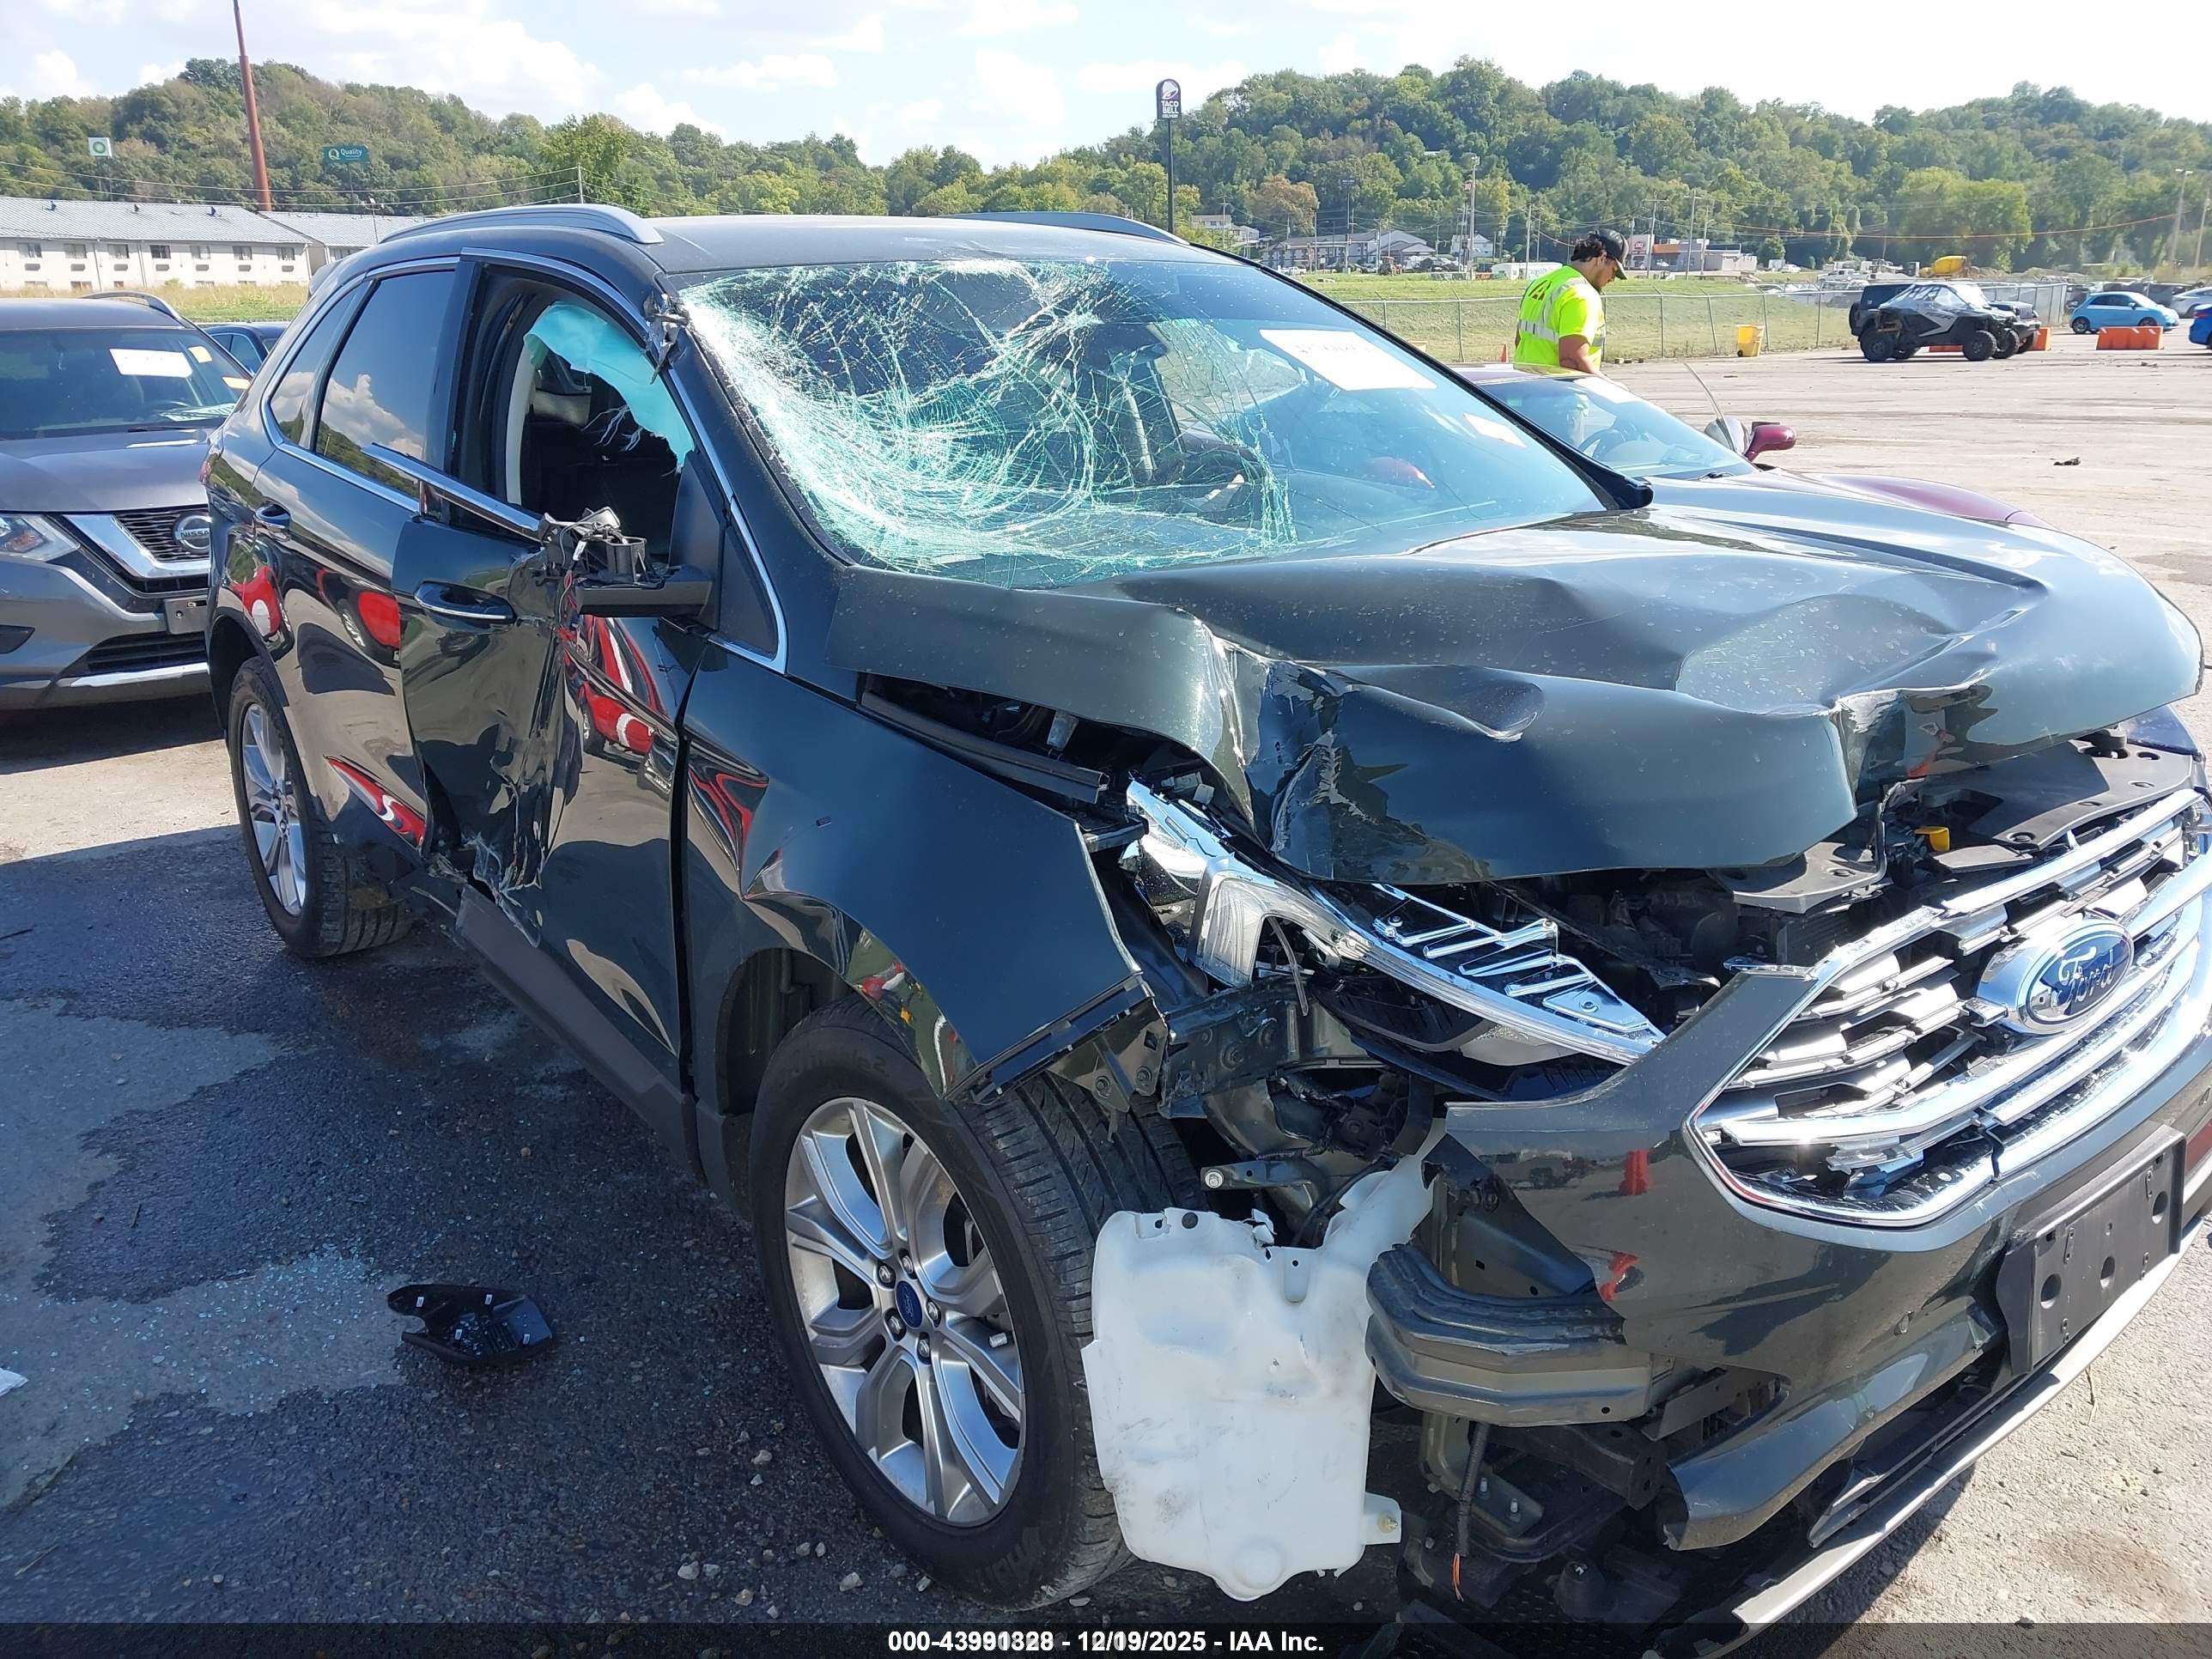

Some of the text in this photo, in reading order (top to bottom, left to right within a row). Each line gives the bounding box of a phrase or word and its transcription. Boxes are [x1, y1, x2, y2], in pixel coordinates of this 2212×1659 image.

[340, 148, 362, 157] Quality
[180, 528, 210, 538] NISSA
[2055, 946, 2115, 1013] Ford
